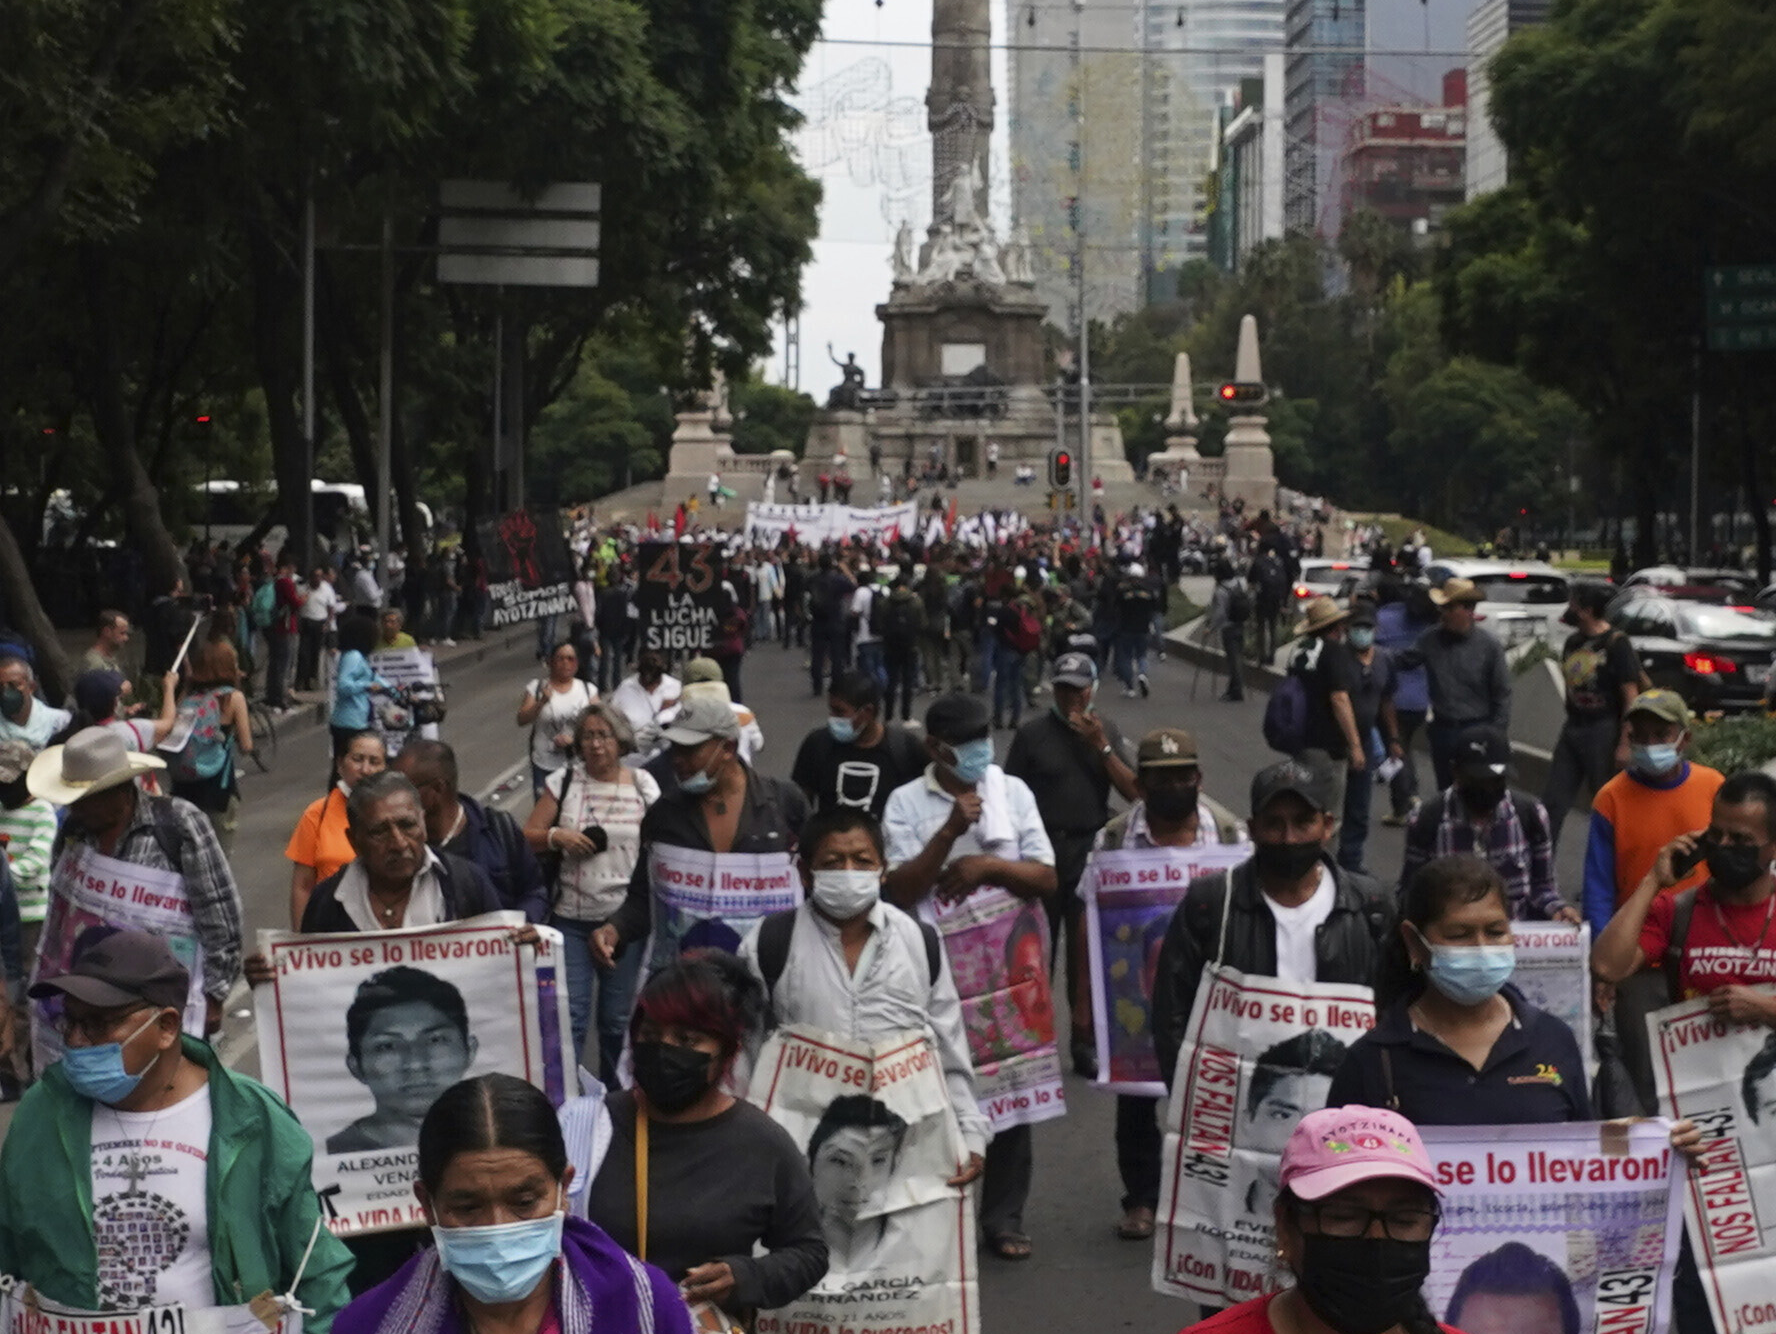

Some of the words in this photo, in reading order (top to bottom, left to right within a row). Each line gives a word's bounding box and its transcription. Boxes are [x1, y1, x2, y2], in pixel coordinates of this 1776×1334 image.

[646, 542, 714, 594] 43
[668, 593, 695, 608] LA
[651, 607, 718, 627] LUCHA
[647, 626, 714, 651] SIGUE
[87, 877, 105, 893] se
[110, 879, 126, 898] lo
[350, 947, 374, 966] se
[382, 941, 402, 962] lo
[410, 938, 510, 961] llevaron!
[1210, 989, 1262, 1021] ¡Vivo
[1269, 1000, 1295, 1023] se
[1300, 1001, 1320, 1026] lo
[786, 1045, 838, 1078] ¡Vivo
[842, 1065, 865, 1087] se
[988, 1095, 1029, 1122] ¡Vivo
[1033, 1089, 1050, 1106] lo
[1363, 1137, 1379, 1150] 43
[1437, 1161, 1473, 1185] se
[1487, 1154, 1516, 1184] lo
[1528, 1149, 1670, 1183] llevaron!
[1176, 1251, 1215, 1281] ¡Con
[1598, 1267, 1654, 1307] 43!
